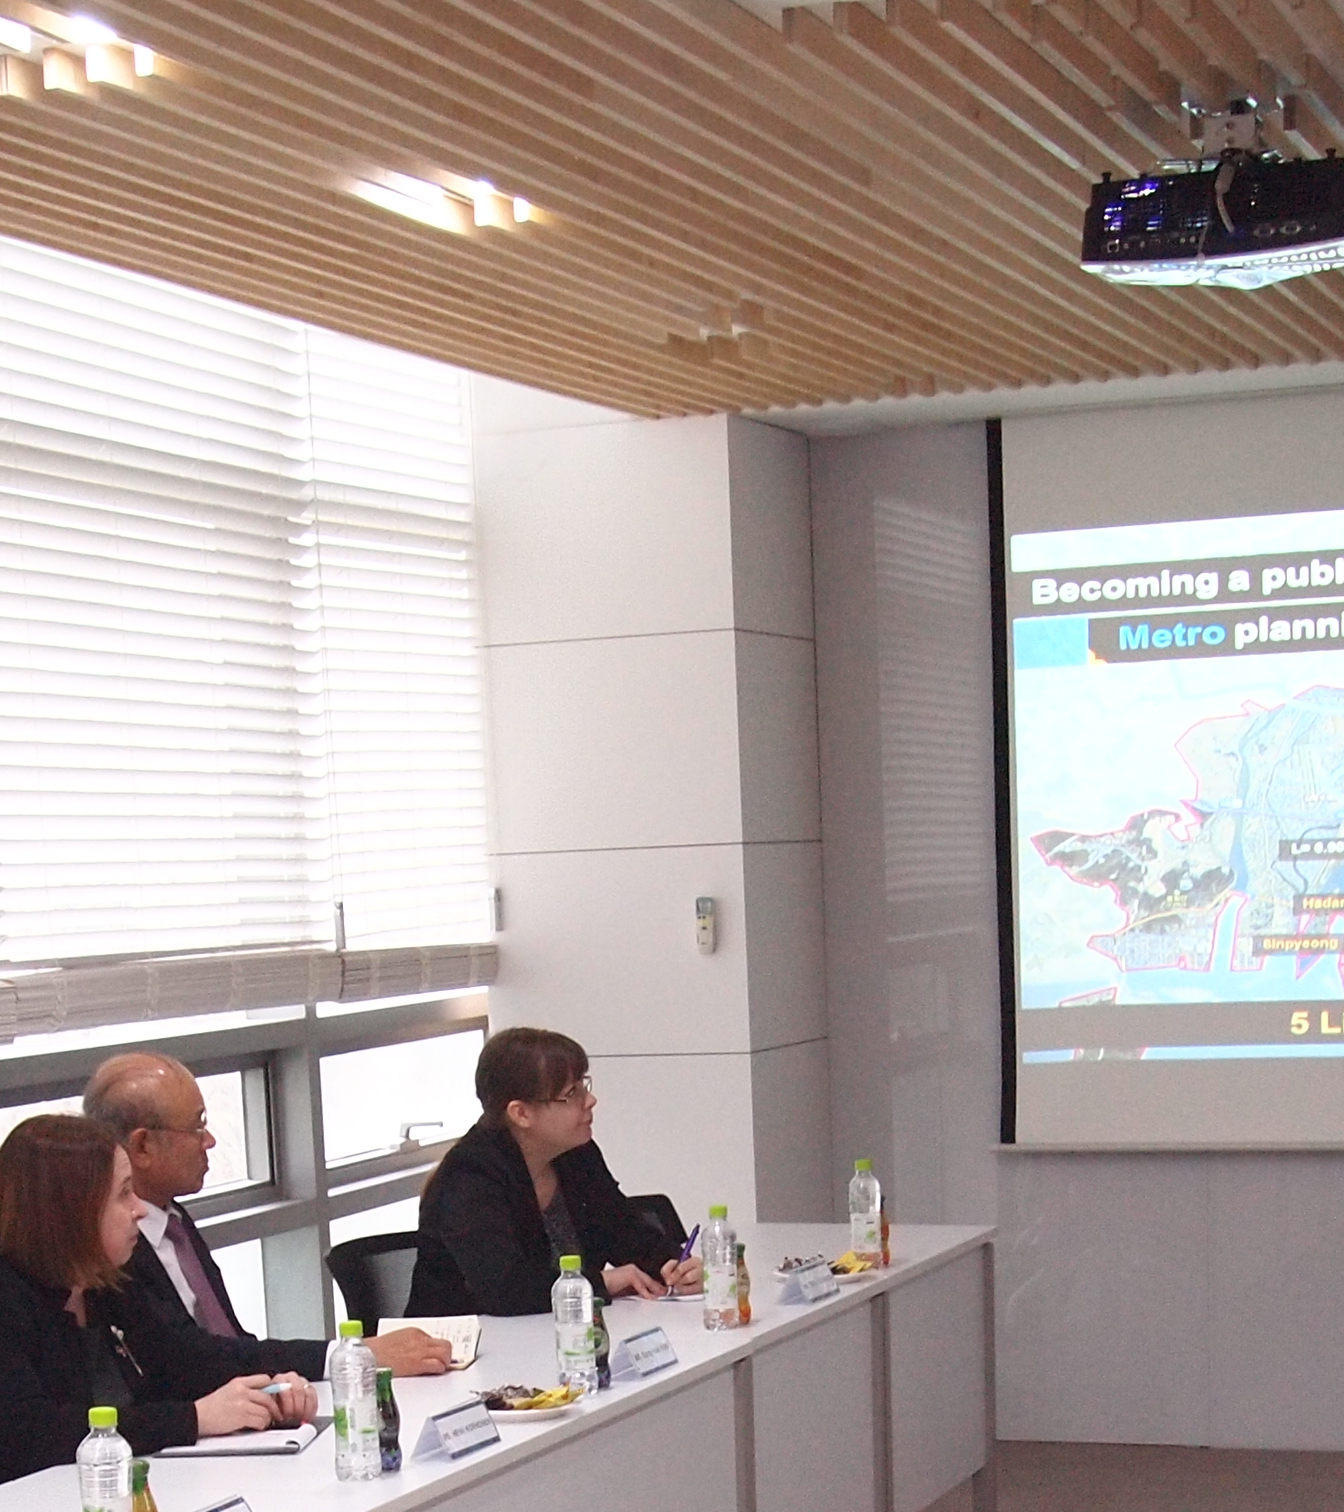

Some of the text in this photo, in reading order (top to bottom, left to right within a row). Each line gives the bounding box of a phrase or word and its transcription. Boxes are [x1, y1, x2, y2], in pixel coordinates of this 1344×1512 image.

[1031, 569, 1220, 605] Becoming
[1227, 568, 1251, 592] a
[1119, 621, 1226, 651] Metro
[1290, 1011, 1310, 1035] 5
